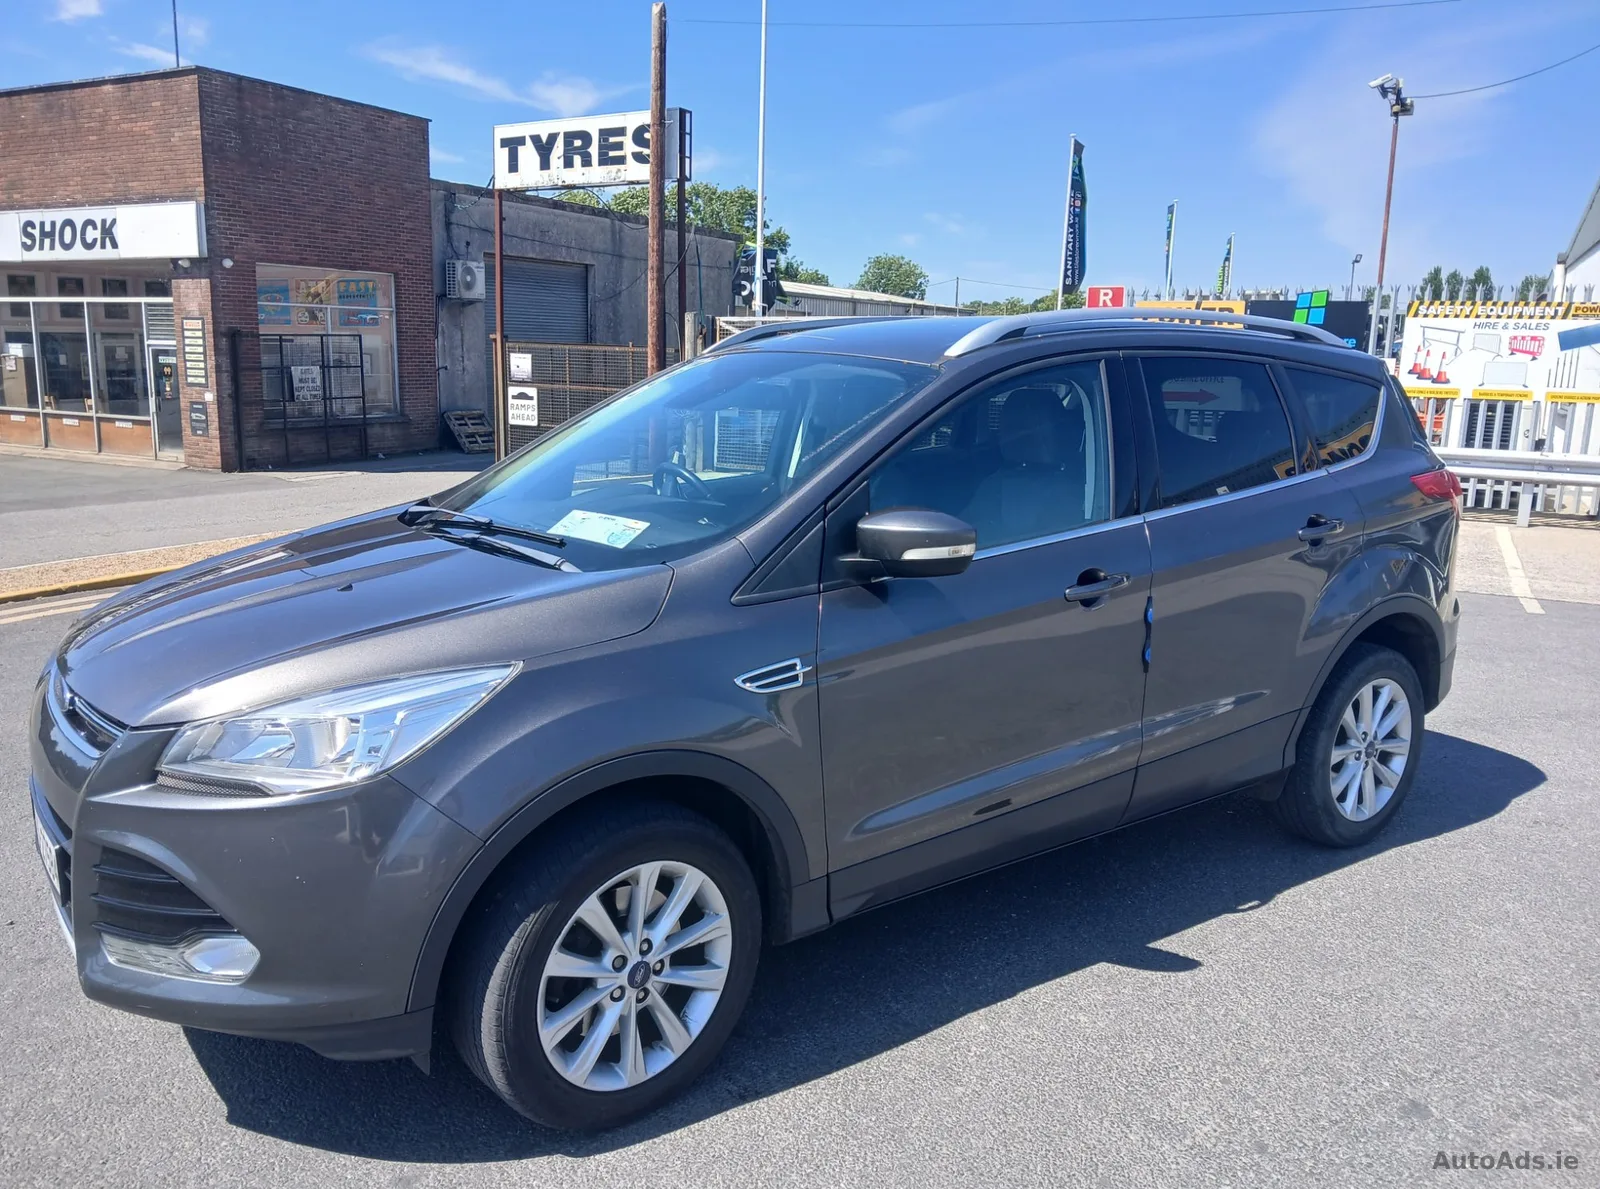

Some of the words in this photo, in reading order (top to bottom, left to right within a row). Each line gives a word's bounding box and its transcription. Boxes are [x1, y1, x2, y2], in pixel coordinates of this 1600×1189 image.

[499, 123, 651, 174] TYRES
[20, 217, 119, 252] SHOCK
[1065, 227, 1074, 286] SANITARY
[1099, 289, 1113, 307] R
[1418, 305, 1475, 316] SAFETY
[1477, 305, 1566, 317] EQUIPMENT
[1472, 321, 1500, 330] HIRE
[1501, 322, 1509, 330] &
[1512, 322, 1550, 331] SALES
[510, 403, 536, 412] RAMPS
[510, 413, 536, 422] AHEAD
